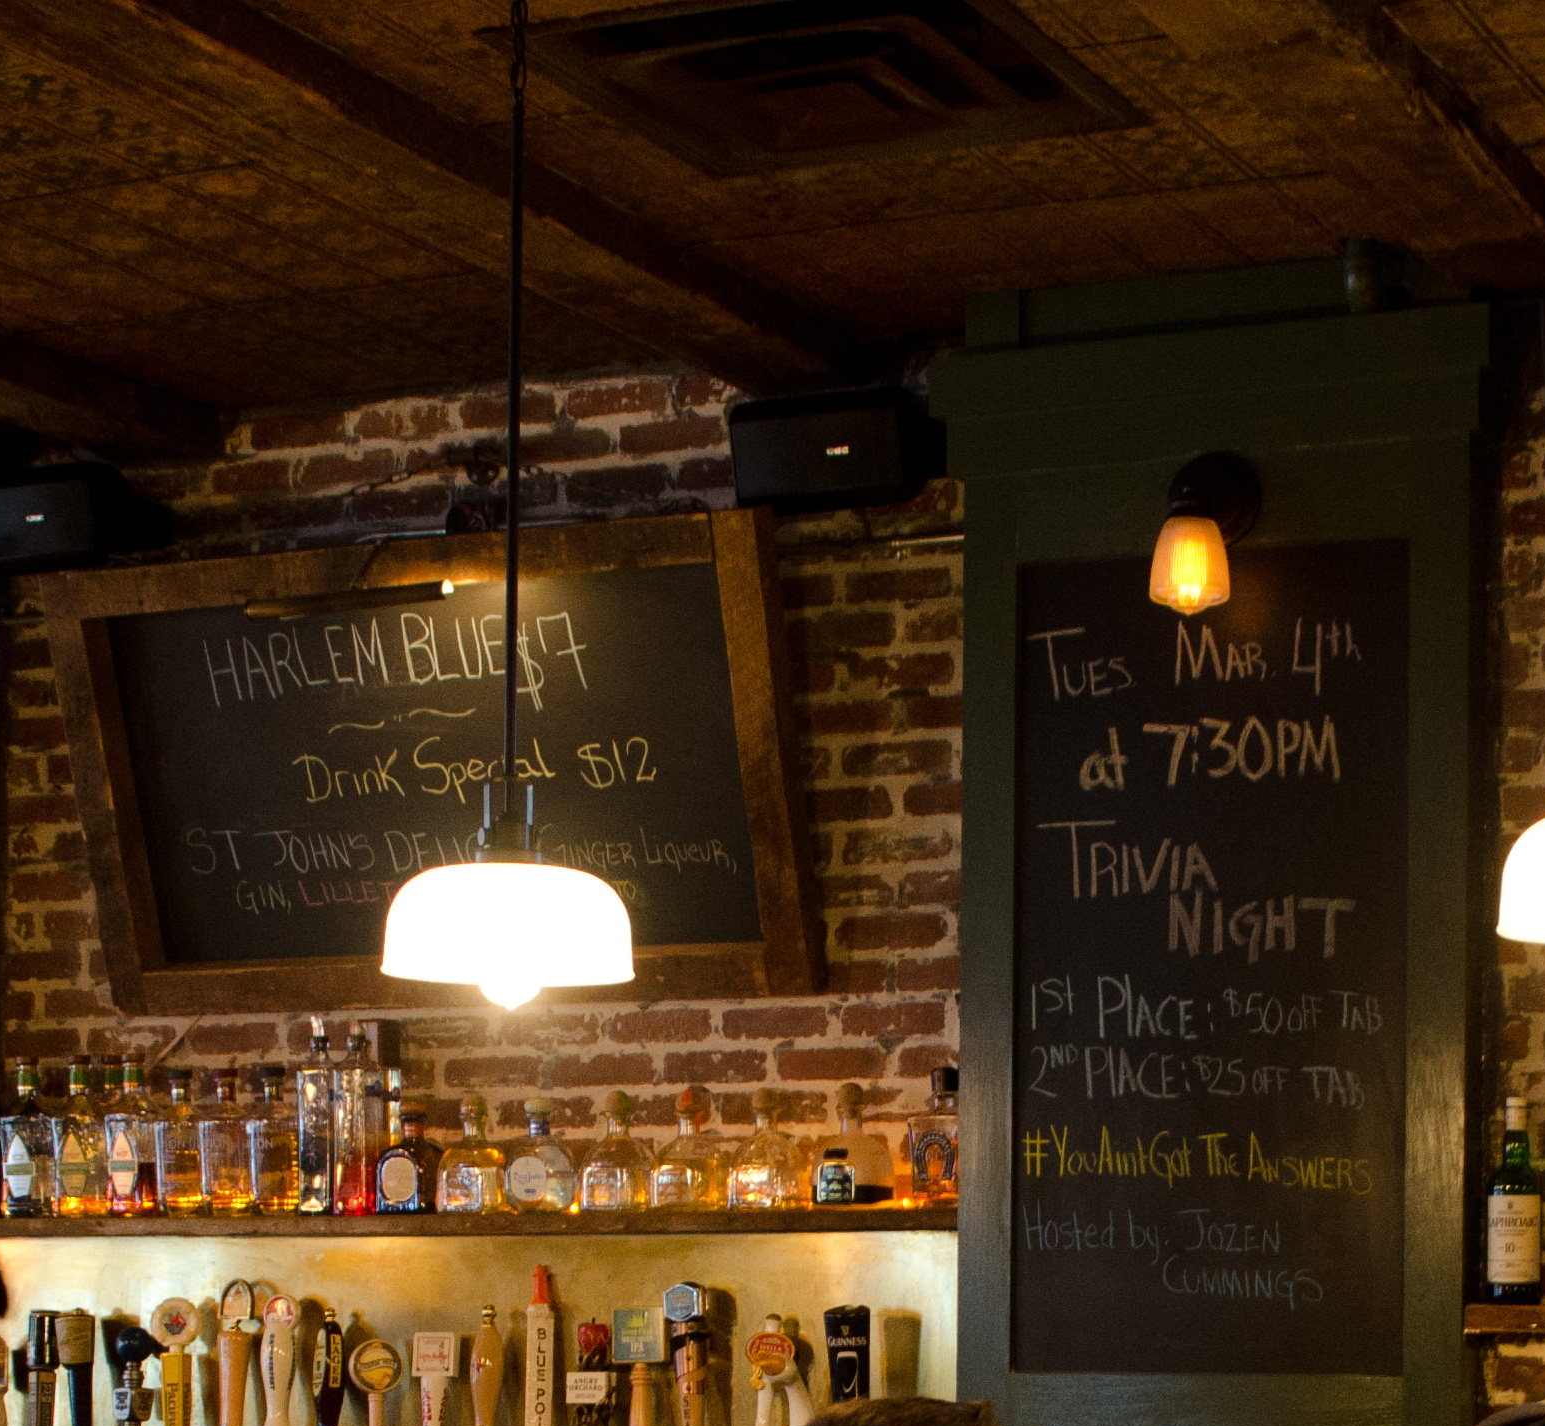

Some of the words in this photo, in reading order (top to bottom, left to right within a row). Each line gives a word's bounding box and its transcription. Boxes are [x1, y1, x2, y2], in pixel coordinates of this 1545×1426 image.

[204, 621, 388, 707] HARLEM
[400, 612, 504, 685] BLUE
[413, 736, 556, 804] Specal
[576, 736, 657, 790] $12
[1080, 727, 1127, 790] at
[1142, 715, 1341, 788] 7:30PM
[186, 826, 240, 876] ST
[1037, 819, 1219, 899] TRIVIA
[1168, 888, 1355, 964] NIGHT
[1223, 986, 1283, 1036] $50
[1327, 988, 1385, 1035] TAB
[1192, 1053, 1246, 1098] $25
[1301, 1064, 1365, 1109] TAB
[1023, 1203, 1115, 1253] Hosted
[1175, 1207, 1281, 1255] JOZEN
[1162, 1254, 1324, 1311] CUMMINGS
[331, 1334, 342, 1386] LAGER
[536, 1327, 548, 1382] BLUE
[827, 1335, 867, 1349] GUINNESS
[569, 1384, 603, 1392] ORCHARD
[573, 1377, 599, 1385] ANGRY
